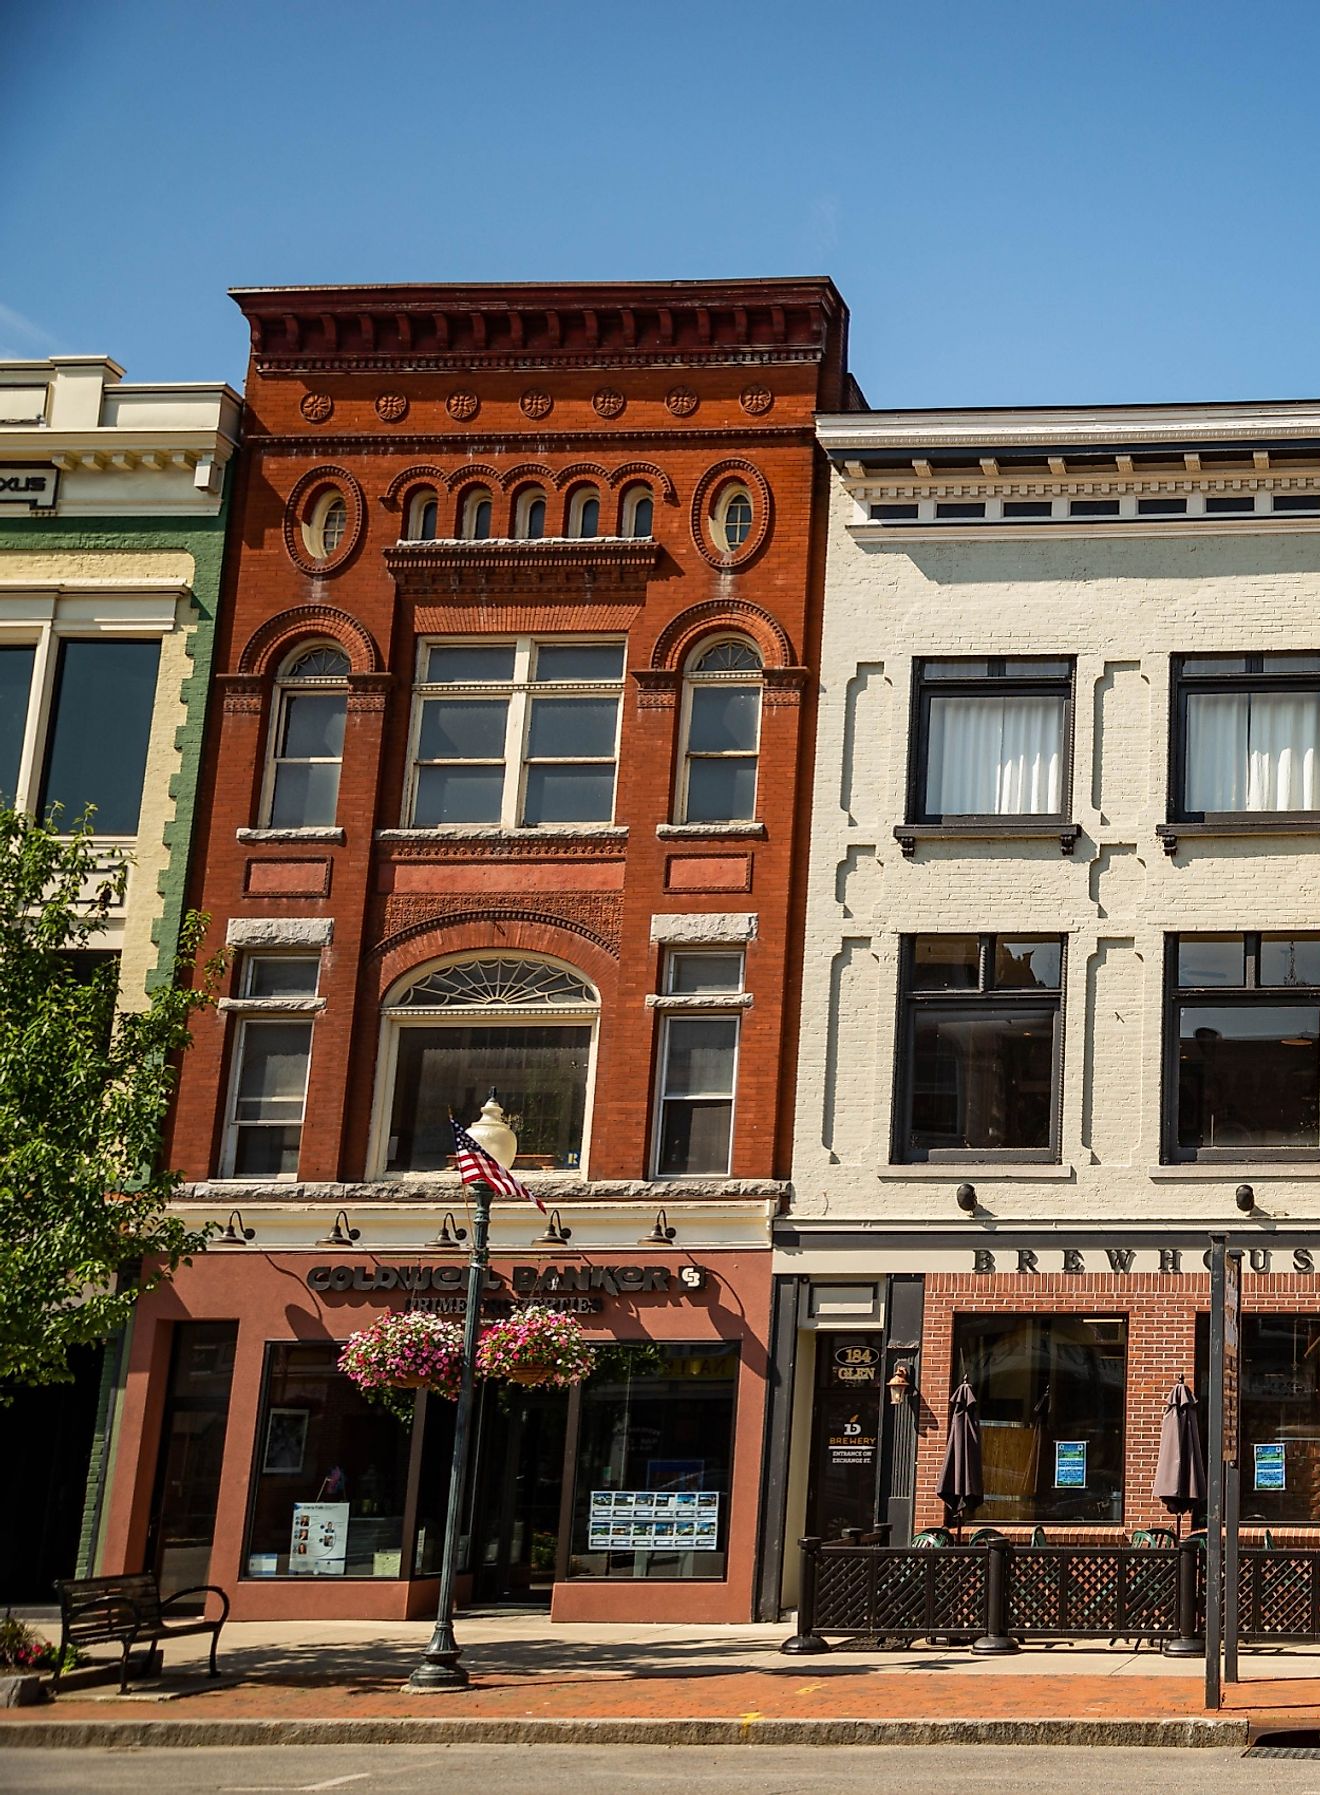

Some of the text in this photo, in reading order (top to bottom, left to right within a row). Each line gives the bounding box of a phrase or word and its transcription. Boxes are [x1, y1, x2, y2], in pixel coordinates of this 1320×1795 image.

[512, 1266, 671, 1296] BANKER
[845, 1349, 872, 1363] 184
[838, 1367, 876, 1380] GLEN
[829, 1437, 877, 1445] BREWERY
